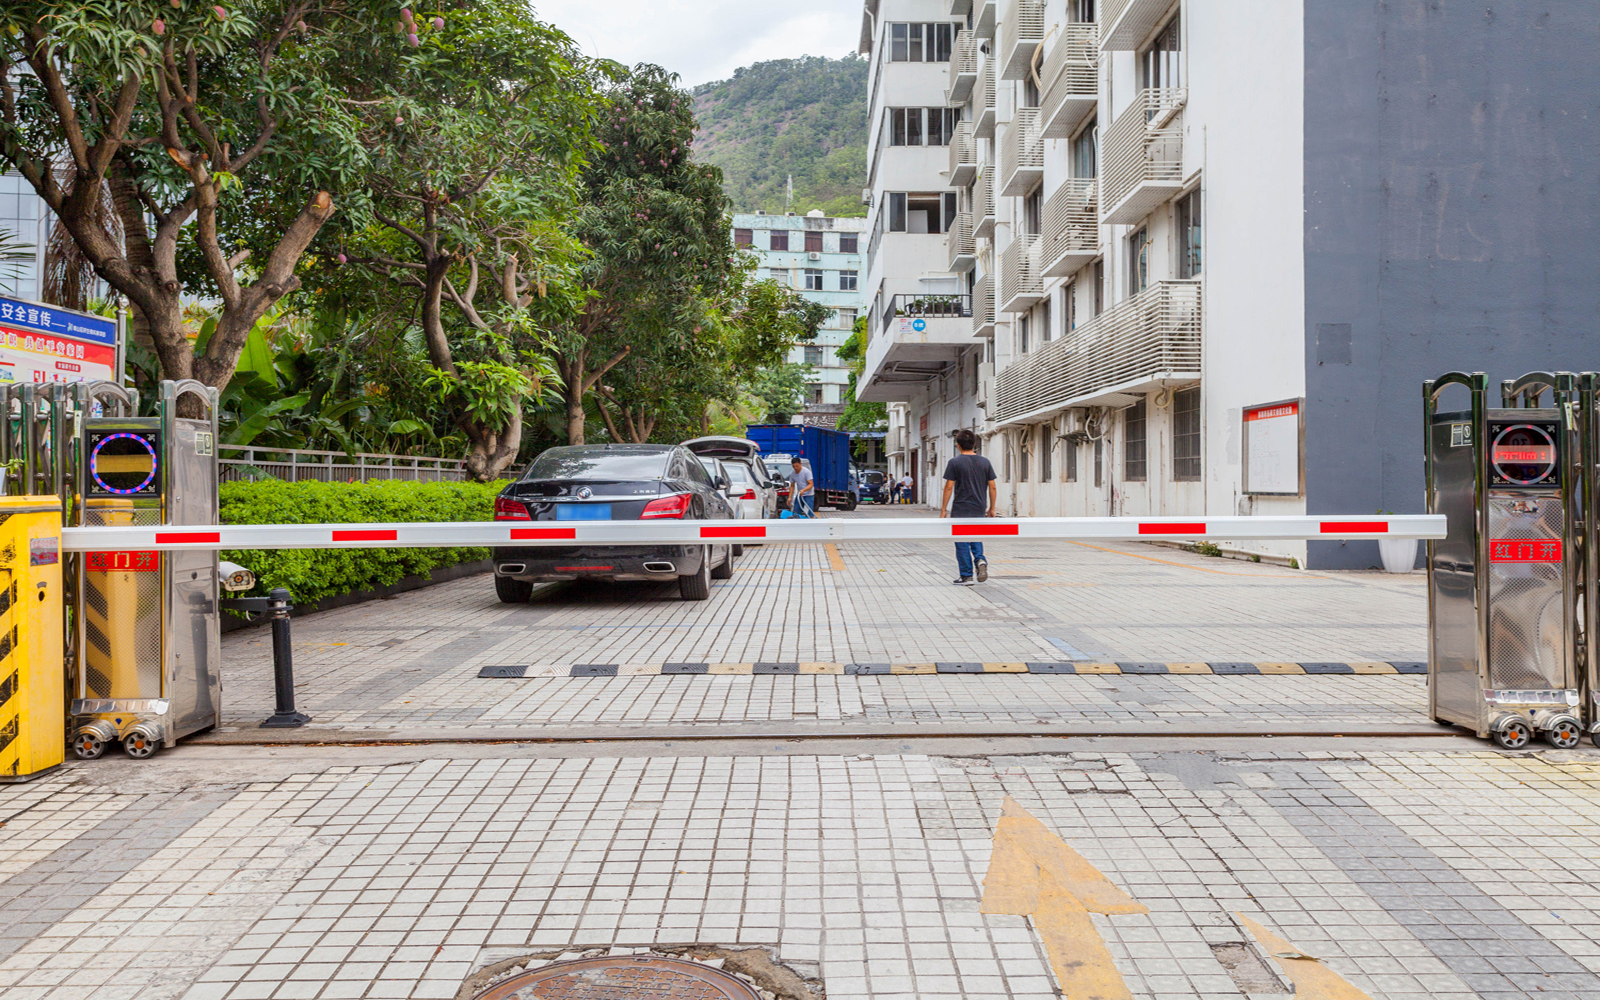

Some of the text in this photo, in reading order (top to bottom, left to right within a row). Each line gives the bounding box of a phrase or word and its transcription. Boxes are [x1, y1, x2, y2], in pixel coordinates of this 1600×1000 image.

[1495, 543, 1557, 558] 红门开
[91, 551, 154, 568] 红门开
